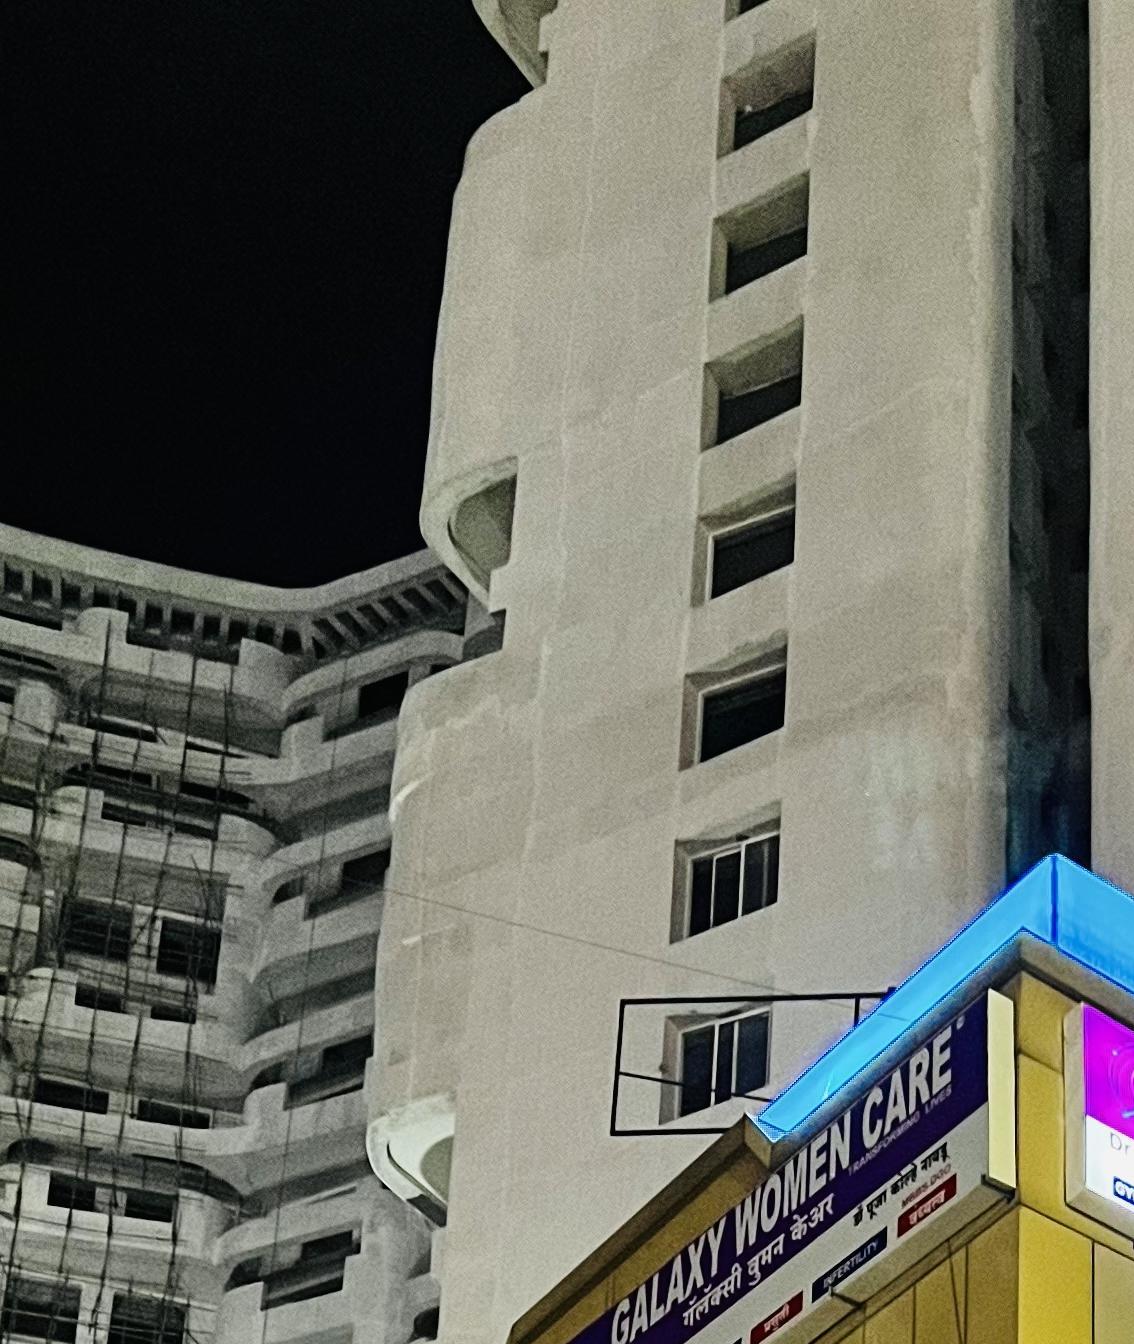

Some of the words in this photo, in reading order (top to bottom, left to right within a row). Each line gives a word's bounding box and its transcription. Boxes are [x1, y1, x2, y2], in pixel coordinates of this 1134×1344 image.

[734, 1107, 851, 1257] WOMEN
[862, 1025, 952, 1149] CARE
[1110, 1131, 1130, 1156] Dr
[747, 1233, 785, 1287] वुमन
[790, 1193, 835, 1241] केअर
[823, 1240, 879, 1289] INFERTILITY
